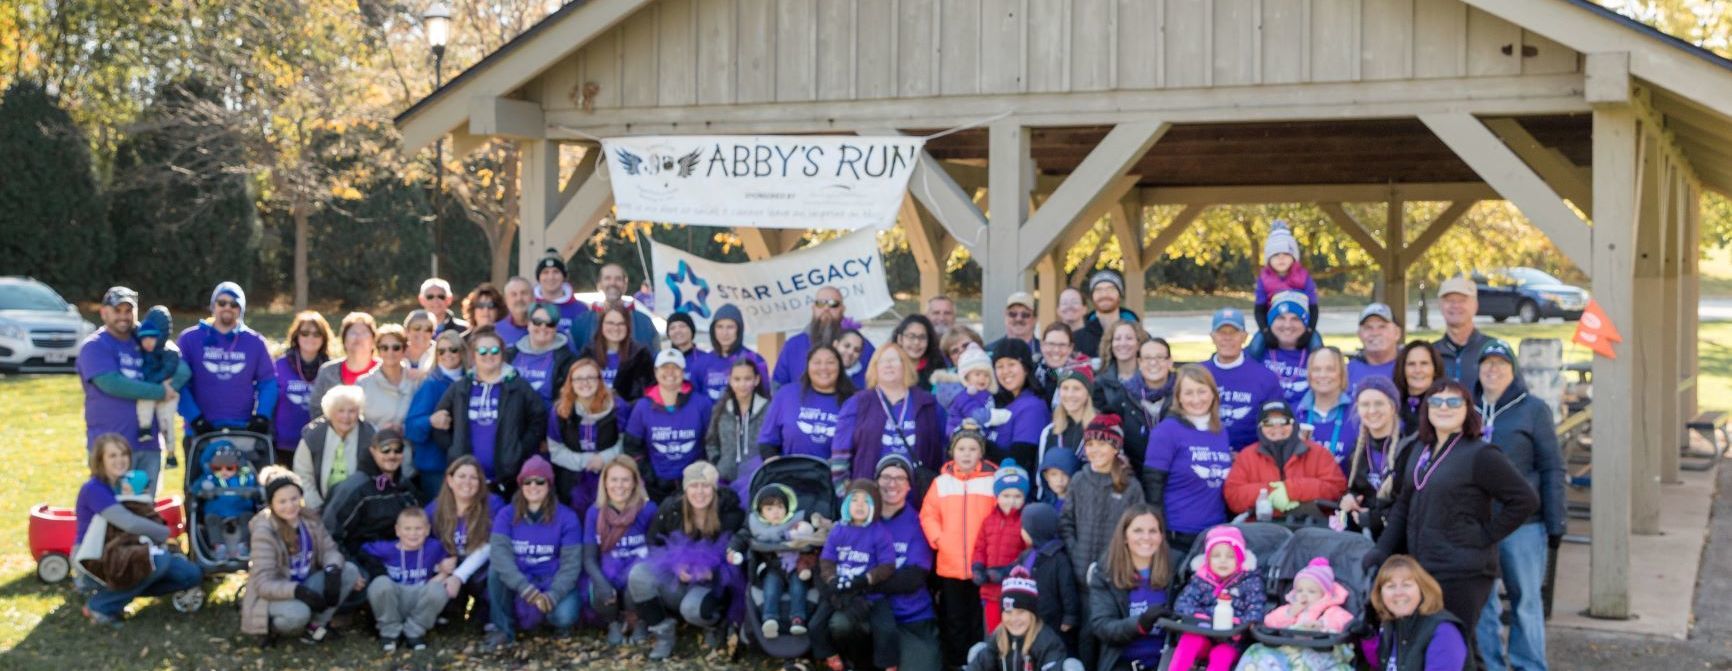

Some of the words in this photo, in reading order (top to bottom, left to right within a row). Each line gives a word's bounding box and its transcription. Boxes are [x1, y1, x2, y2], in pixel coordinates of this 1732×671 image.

[705, 143, 824, 178] ABBY'S
[836, 143, 915, 179] RUN
[716, 283, 772, 302] STAR
[776, 255, 873, 295] LEGACY
[746, 283, 866, 316] OUNDAON
[1231, 390, 1252, 403] RUN
[679, 429, 696, 440] RUN
